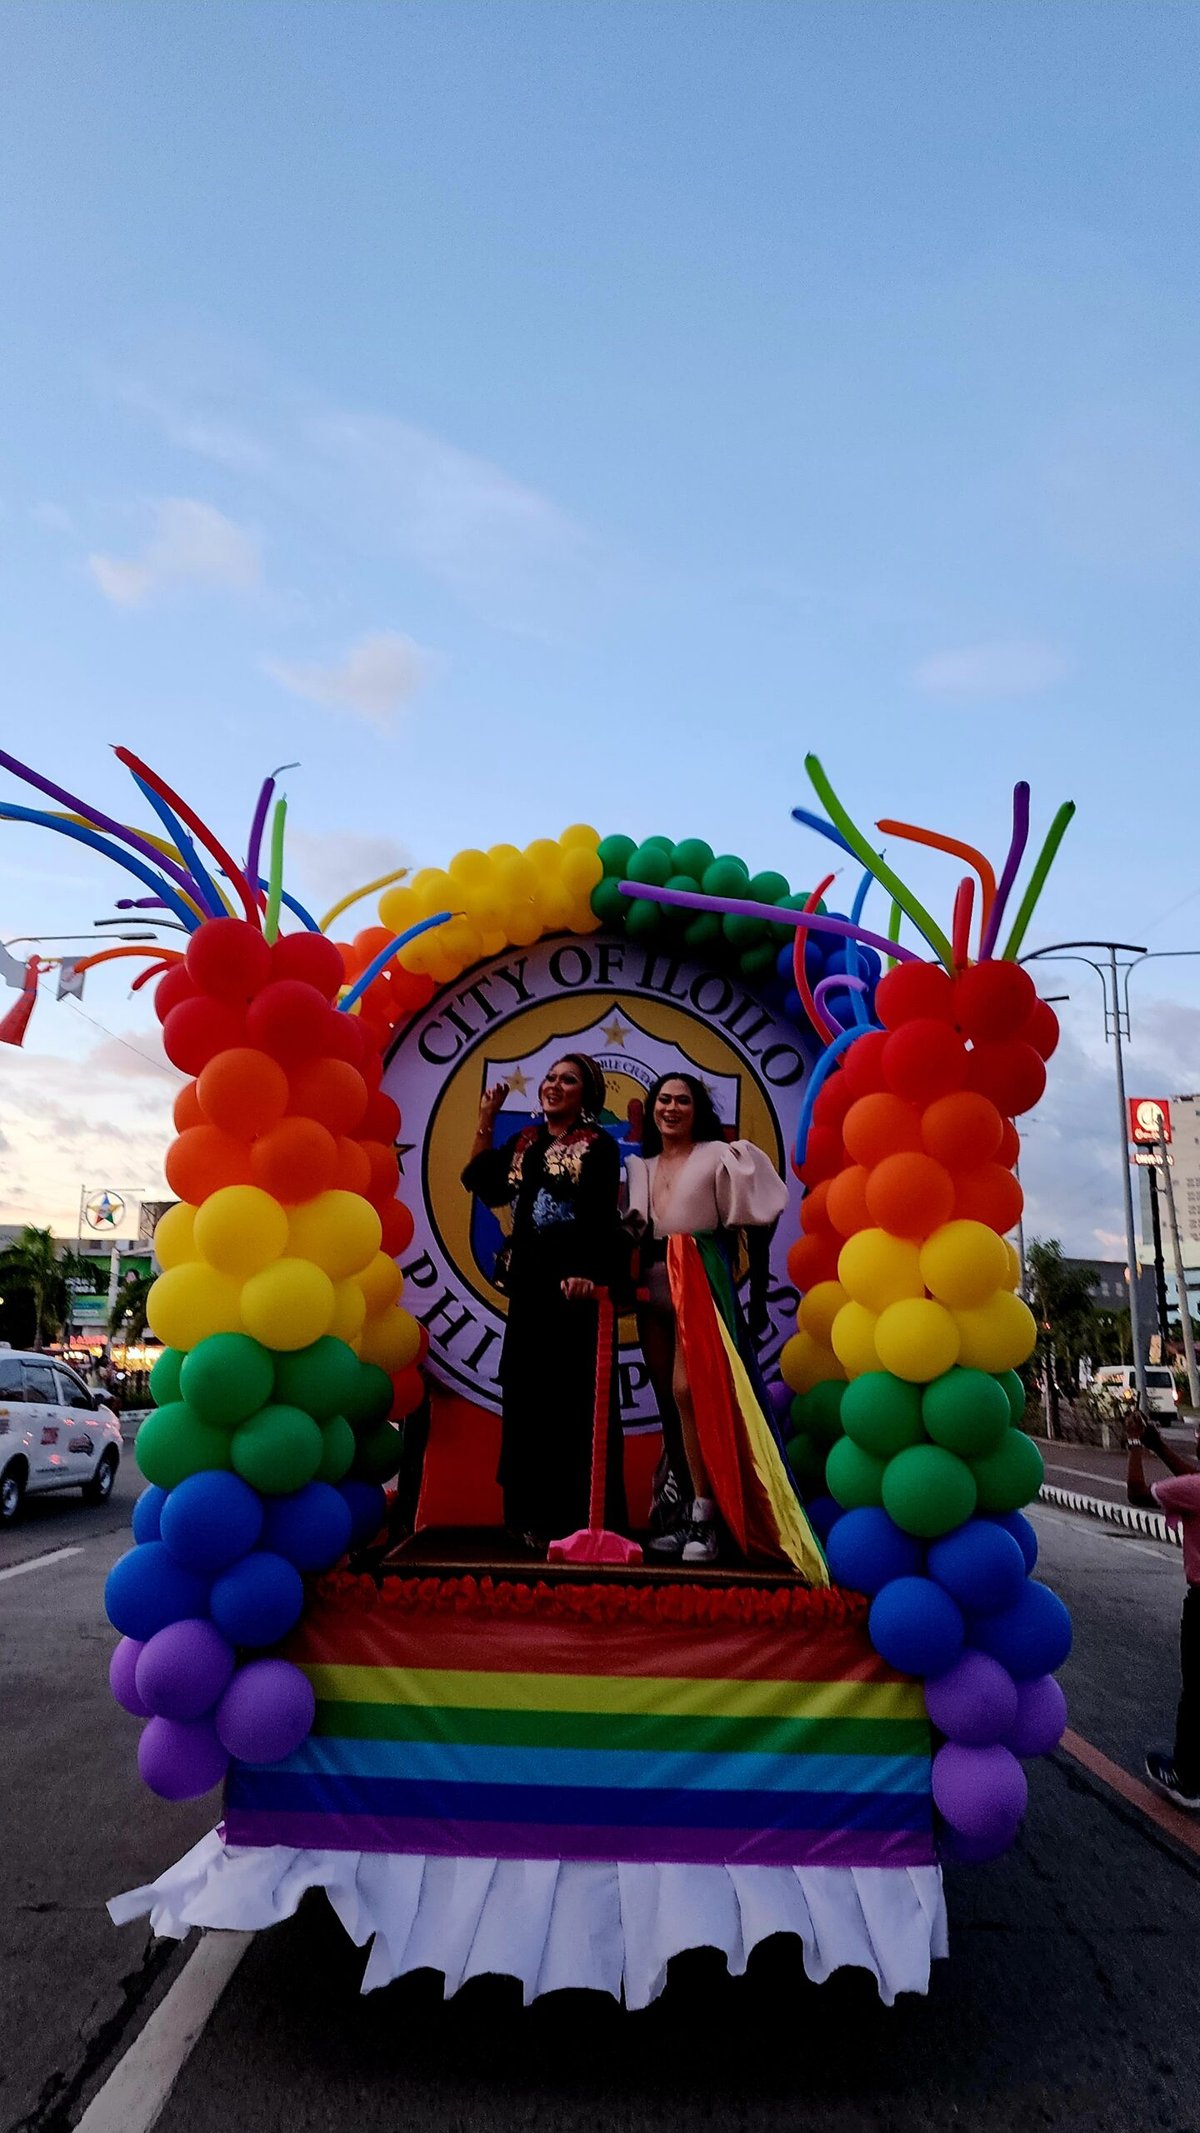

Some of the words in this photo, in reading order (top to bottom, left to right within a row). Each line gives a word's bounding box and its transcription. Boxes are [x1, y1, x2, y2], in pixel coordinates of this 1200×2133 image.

[417, 957, 536, 1065] CITY
[548, 943, 627, 987] OF
[636, 950, 805, 1087] ILOILO
